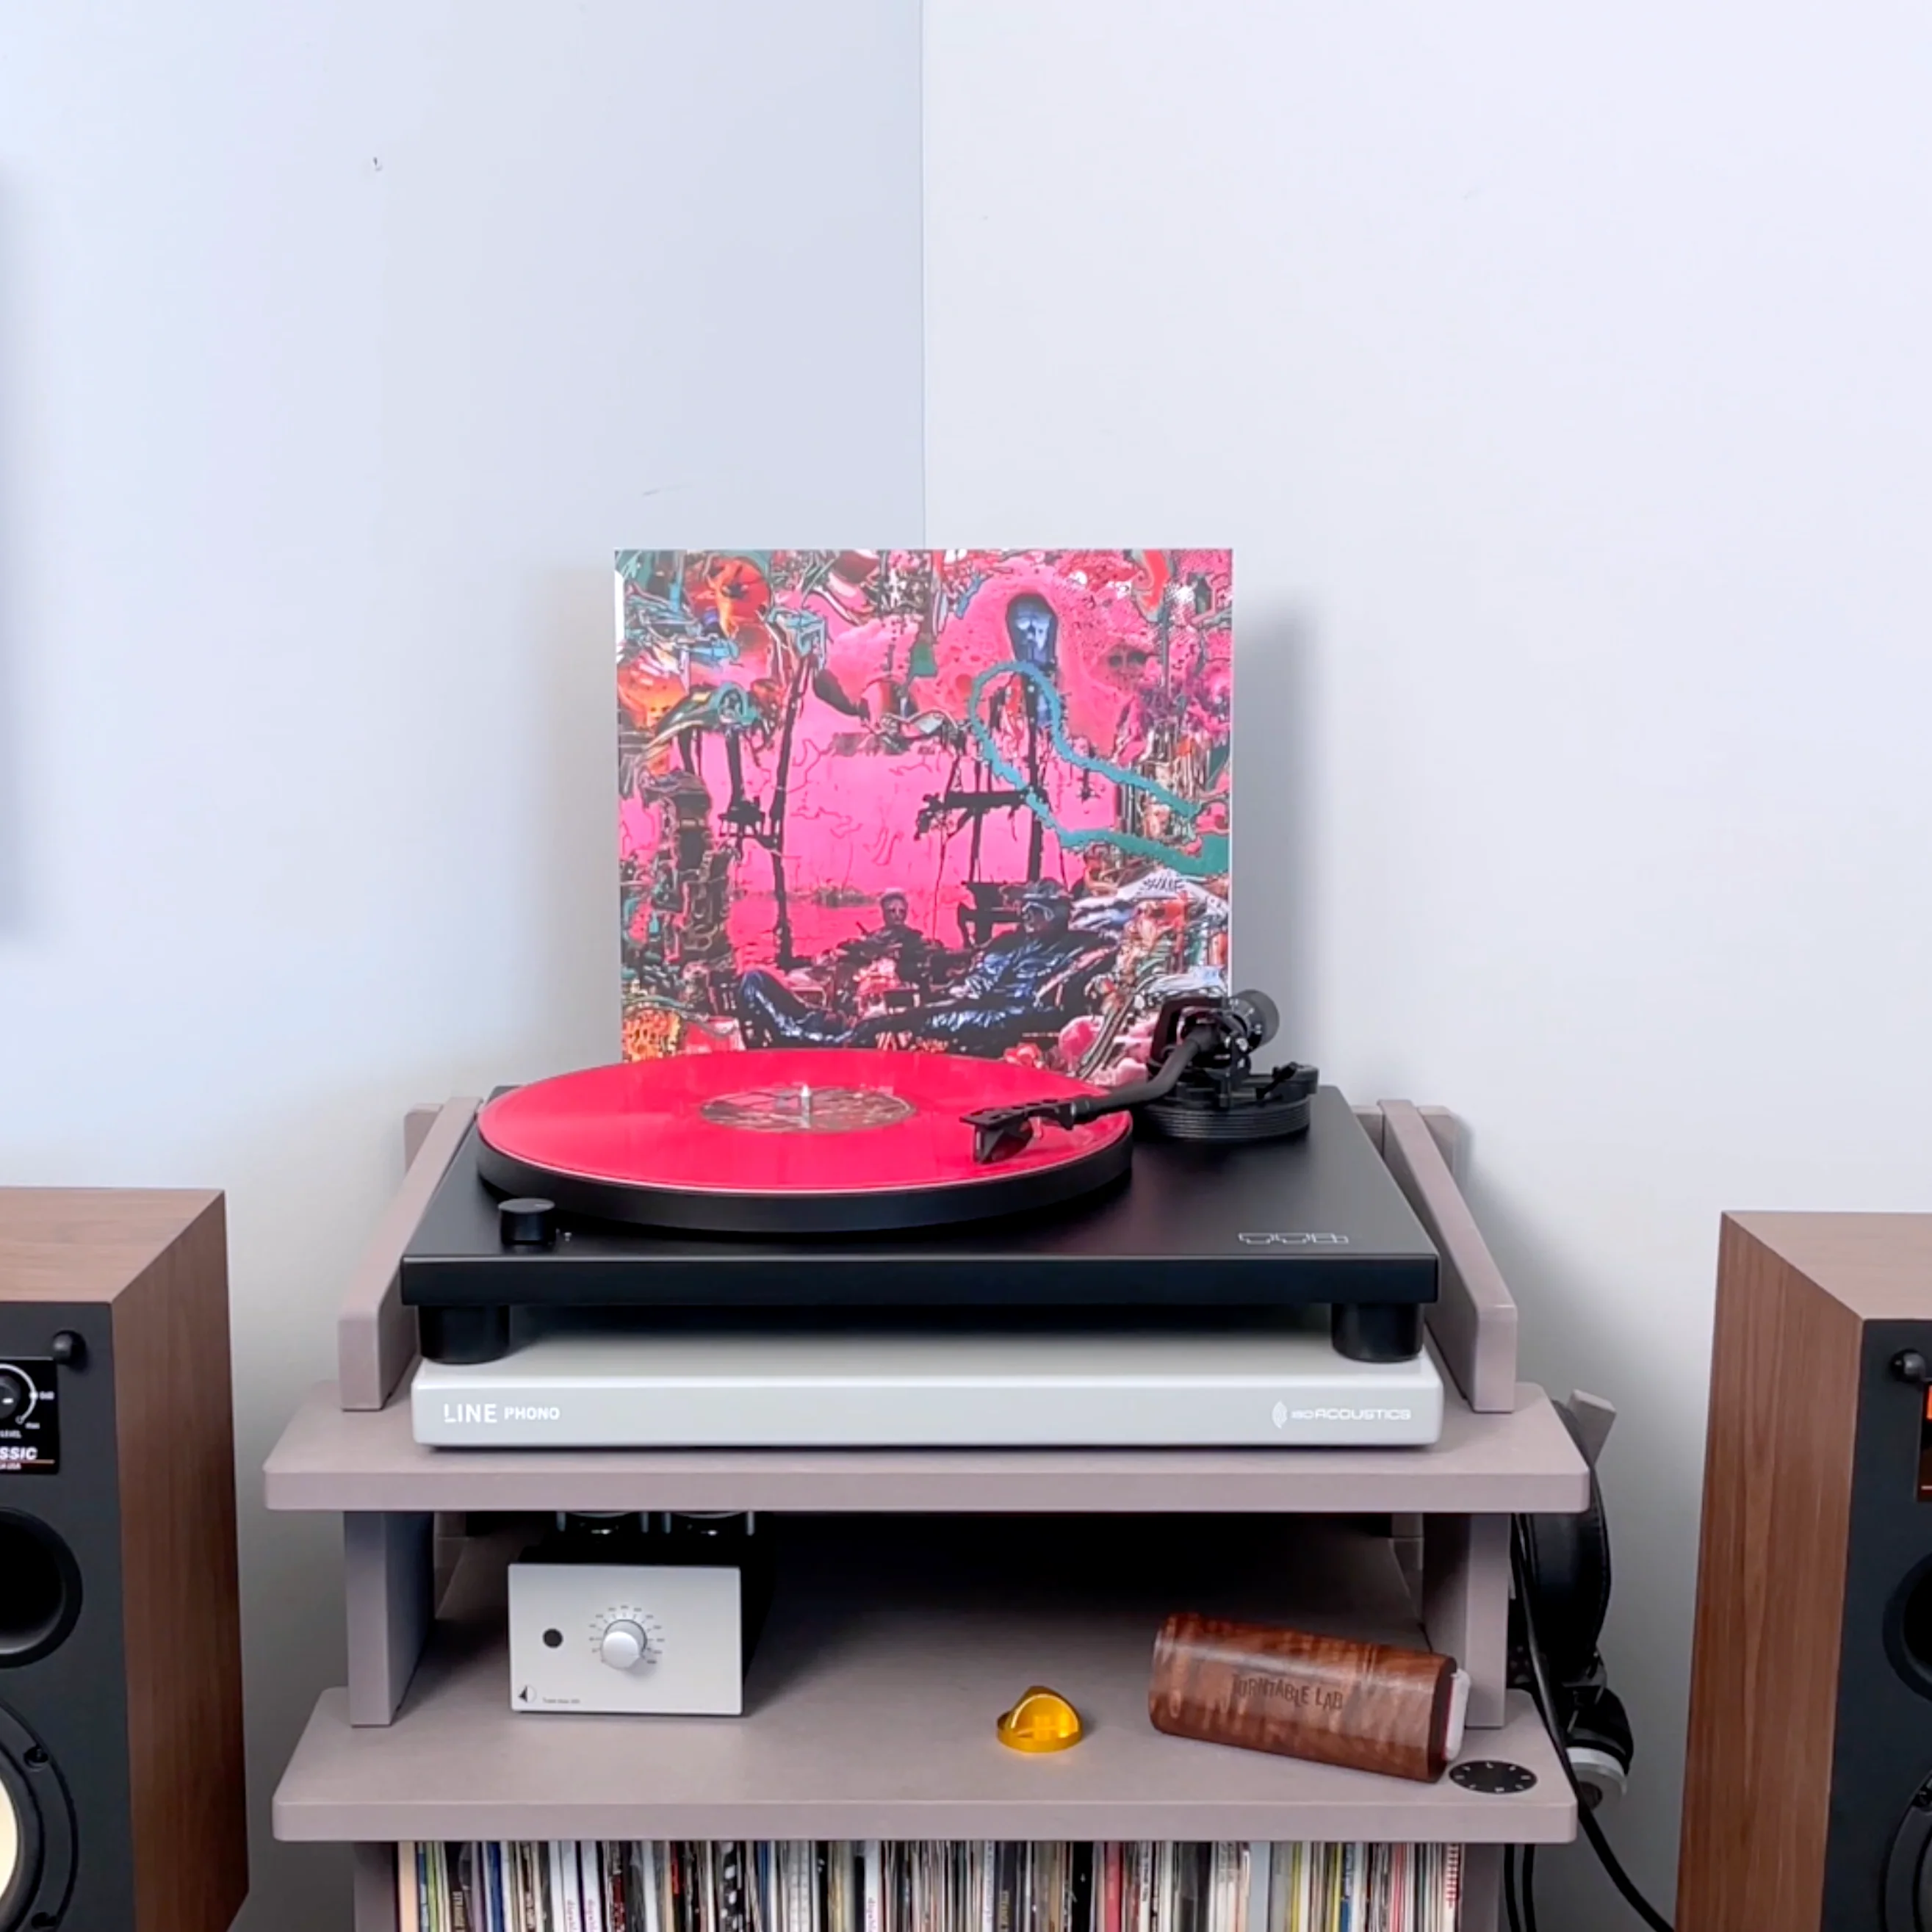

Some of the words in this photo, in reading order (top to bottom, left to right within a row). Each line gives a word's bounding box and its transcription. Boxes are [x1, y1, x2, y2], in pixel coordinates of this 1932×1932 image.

[444, 1403, 497, 1423] LINE
[504, 1407, 561, 1420] PHONO
[1233, 1673, 1311, 1708] TURNTABLE
[1315, 1687, 1344, 1711] LAB
